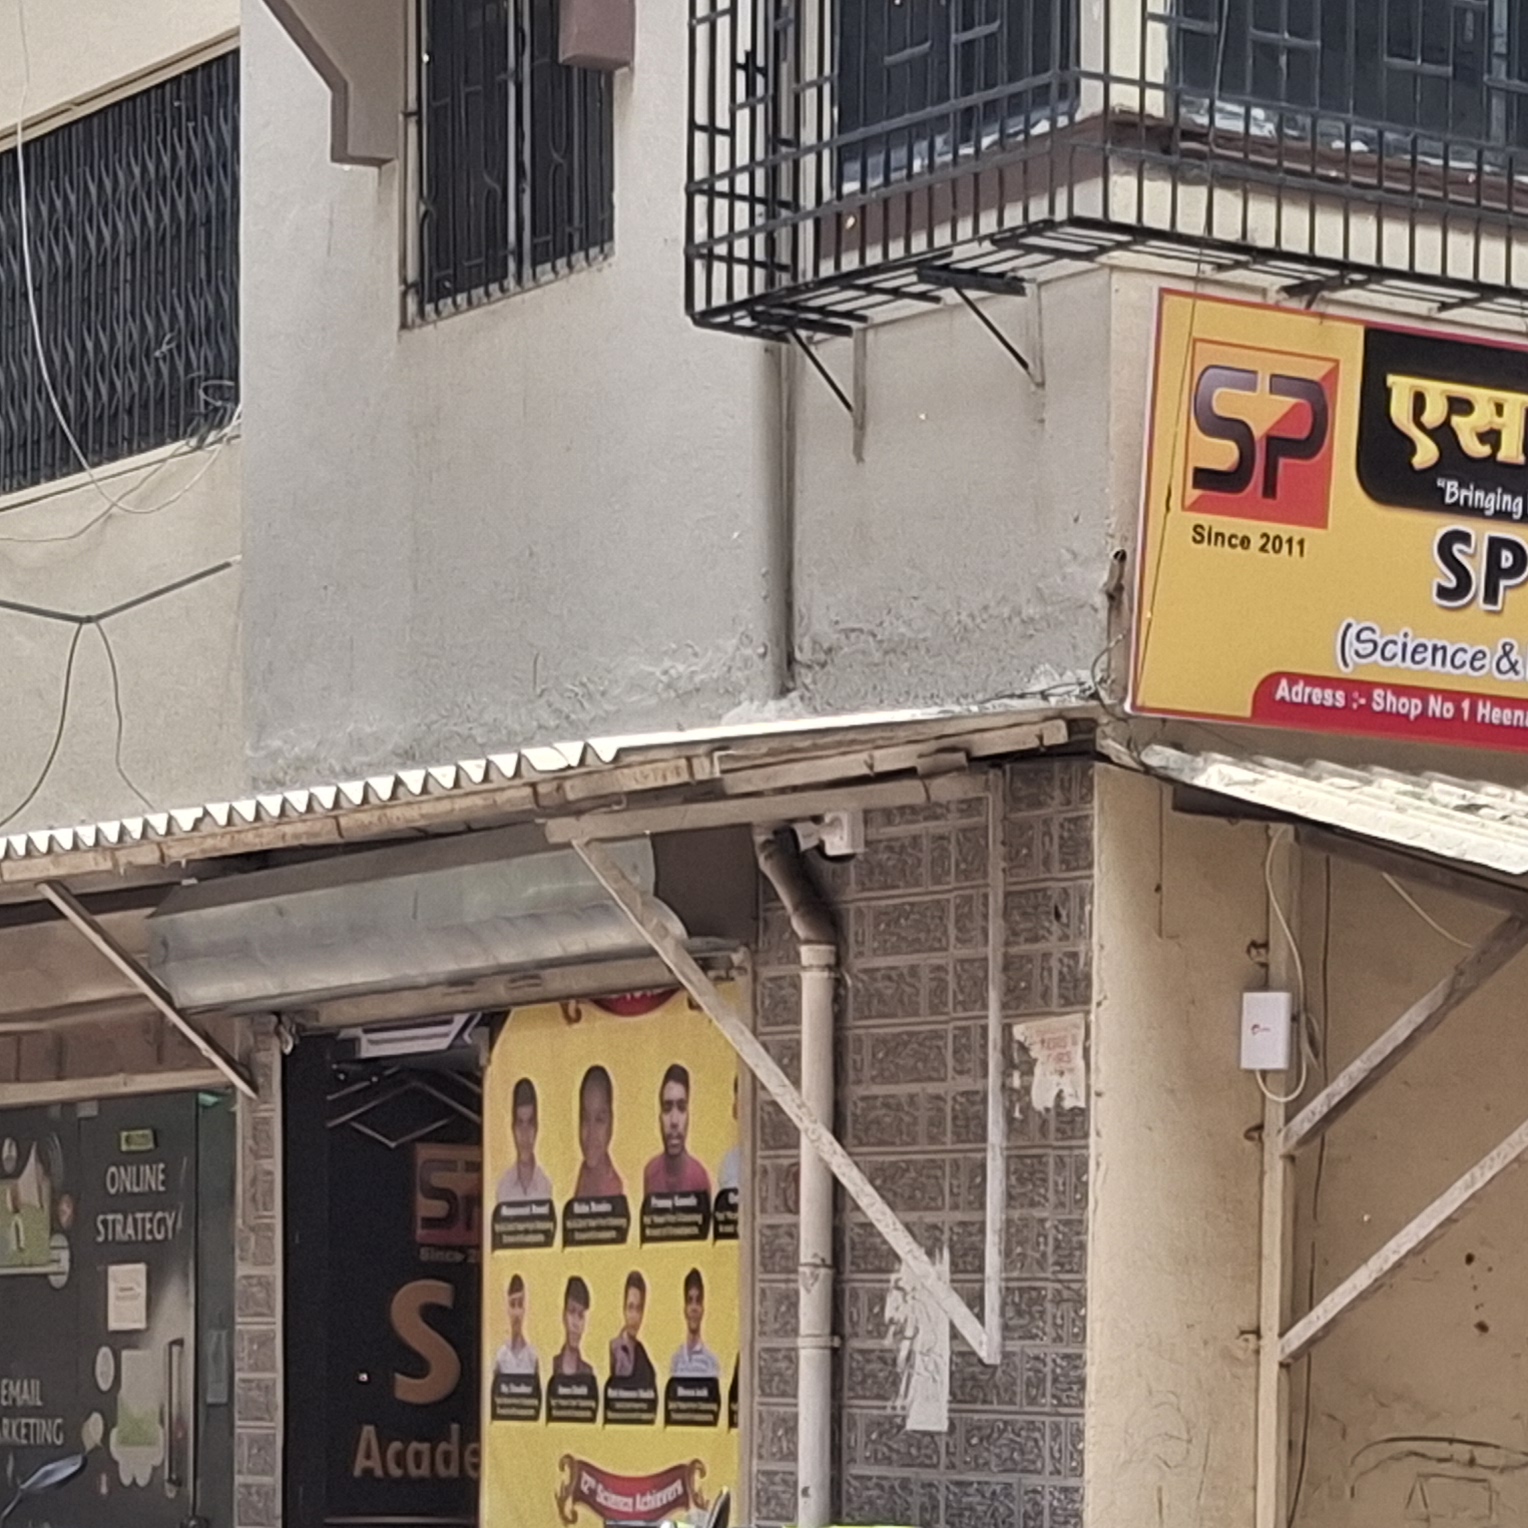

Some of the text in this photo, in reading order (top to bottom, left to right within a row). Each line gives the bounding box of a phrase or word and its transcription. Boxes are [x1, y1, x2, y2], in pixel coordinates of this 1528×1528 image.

[1191, 364, 1329, 501] SP
[1192, 524, 1307, 558] Since 2011
[1340, 622, 1488, 670] (Science
[1494, 641, 1521, 678] &
[1275, 677, 1346, 708] Adress
[1371, 688, 1422, 721] Shop
[1428, 694, 1455, 719] No
[1460, 698, 1470, 722] 1
[106, 1162, 166, 1195] ONLINE
[97, 1211, 176, 1242] STRATEGY
[390, 1279, 461, 1405] S
[1, 1379, 42, 1406] EMAIL
[0, 1417, 63, 1446] RKETING
[353, 1422, 481, 1480] Acade
